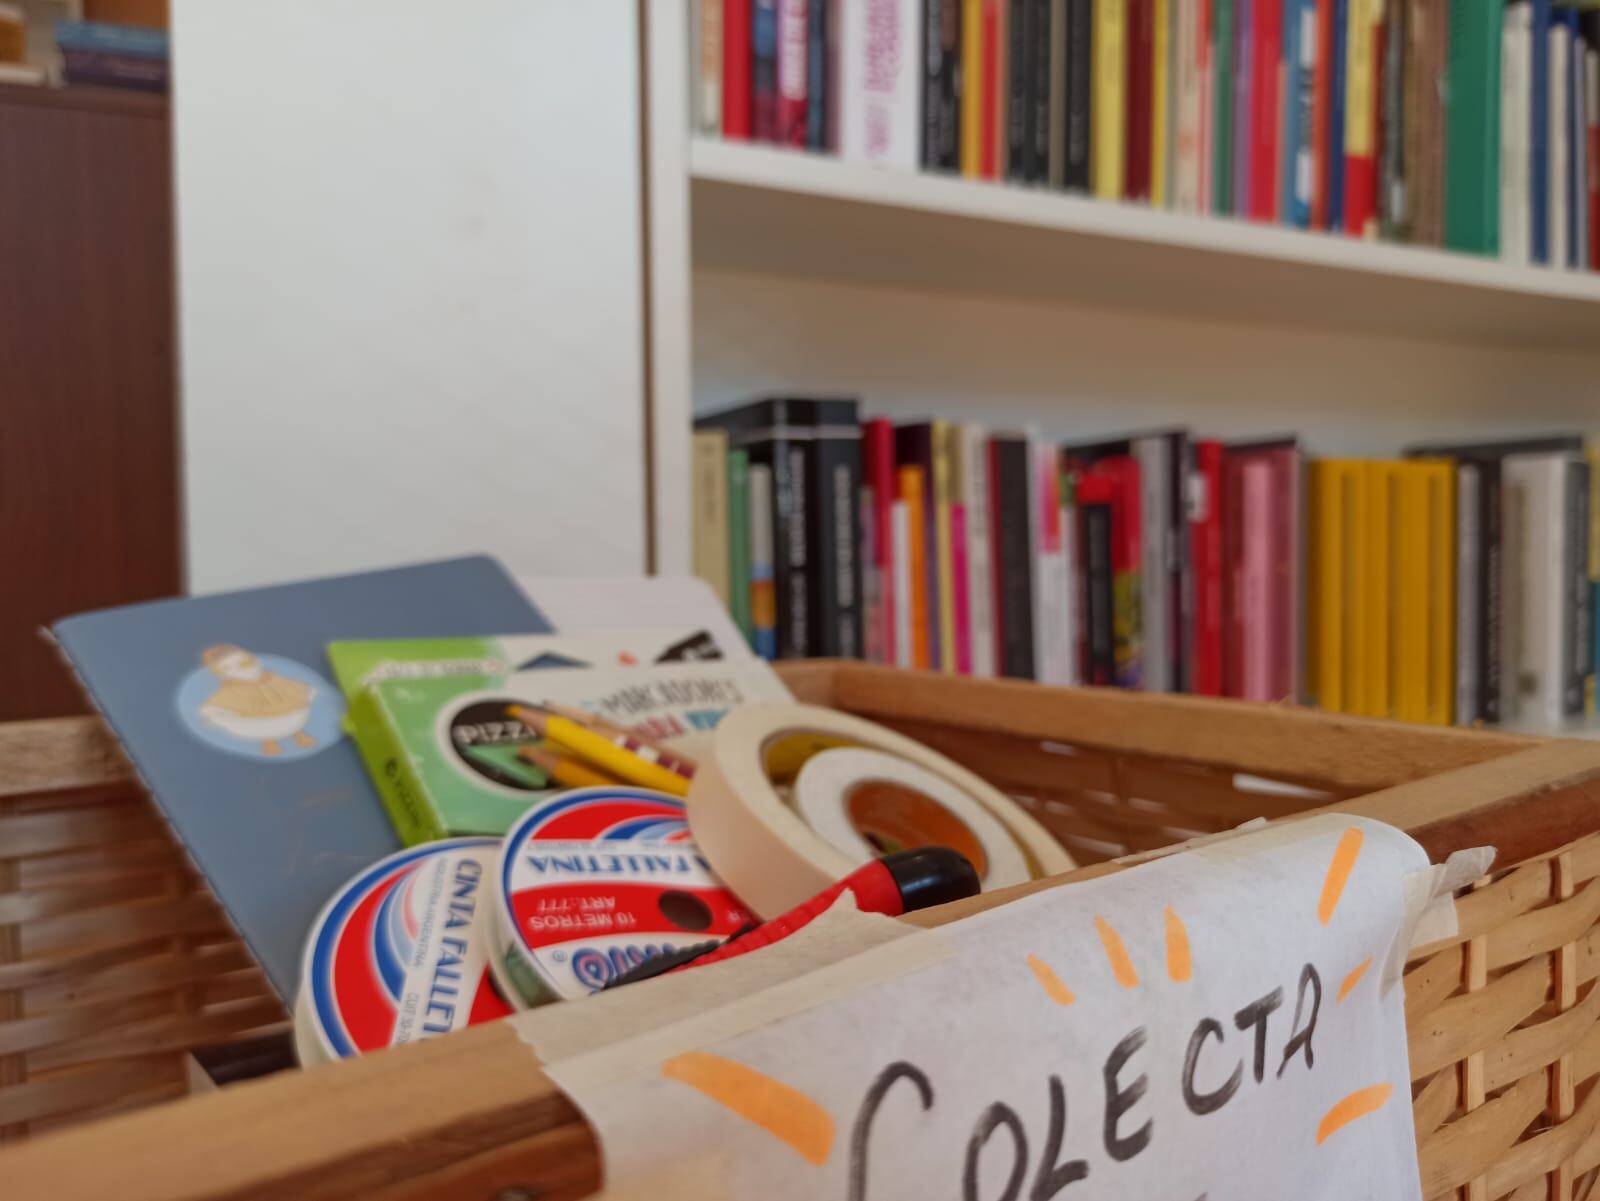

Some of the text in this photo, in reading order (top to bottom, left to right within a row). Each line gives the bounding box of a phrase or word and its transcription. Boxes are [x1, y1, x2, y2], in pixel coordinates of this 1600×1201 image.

[526, 854, 691, 873] FALLETINA
[421, 858, 482, 1034] CINTA FALLET
[529, 911, 637, 931] 10 METROS
[849, 962, 1322, 1201] COLECTA
